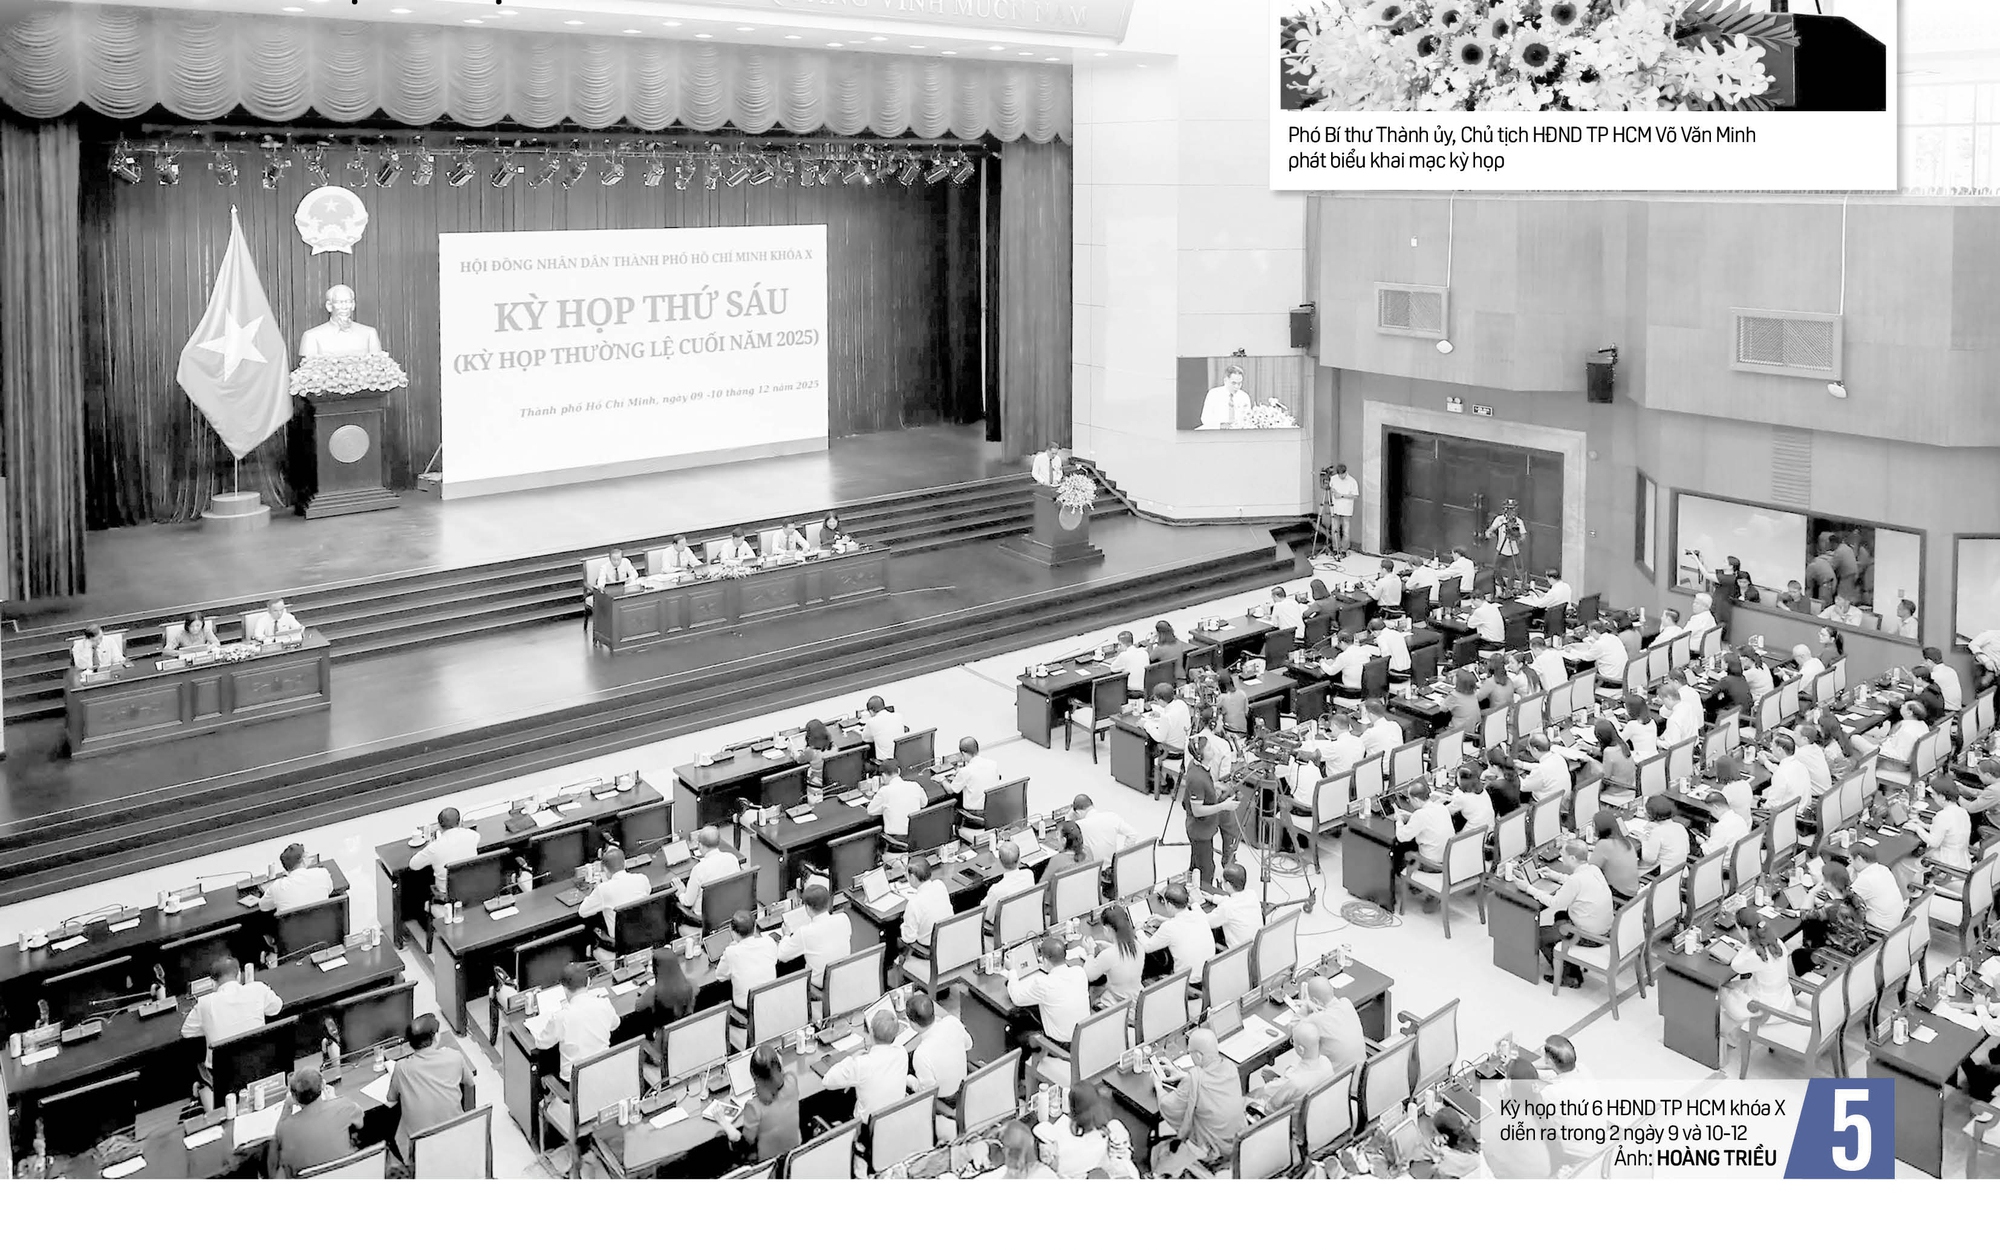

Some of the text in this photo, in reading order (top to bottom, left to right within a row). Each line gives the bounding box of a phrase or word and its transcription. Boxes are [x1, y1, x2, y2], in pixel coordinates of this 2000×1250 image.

[460, 258, 487, 274] HỘI
[492, 257, 533, 271] ĐỒNG
[537, 255, 577, 270] NHÂN
[581, 254, 609, 269] DÂN
[612, 252, 658, 267] THÀNH
[712, 249, 732, 263] CHÍ
[735, 250, 767, 262] MINH
[770, 249, 802, 261] KHÓA
[804, 249, 813, 259] X
[494, 281, 789, 334] KỲ HỌP THỨ SÁU
[453, 328, 819, 374] (KỲ HỌP THƯỜNG LỆ CUỐI NĂM 2025)
[627, 396, 659, 407] Minh,
[690, 391, 703, 401] 09
[758, 385, 770, 394] 12
[796, 380, 819, 391] 2025
